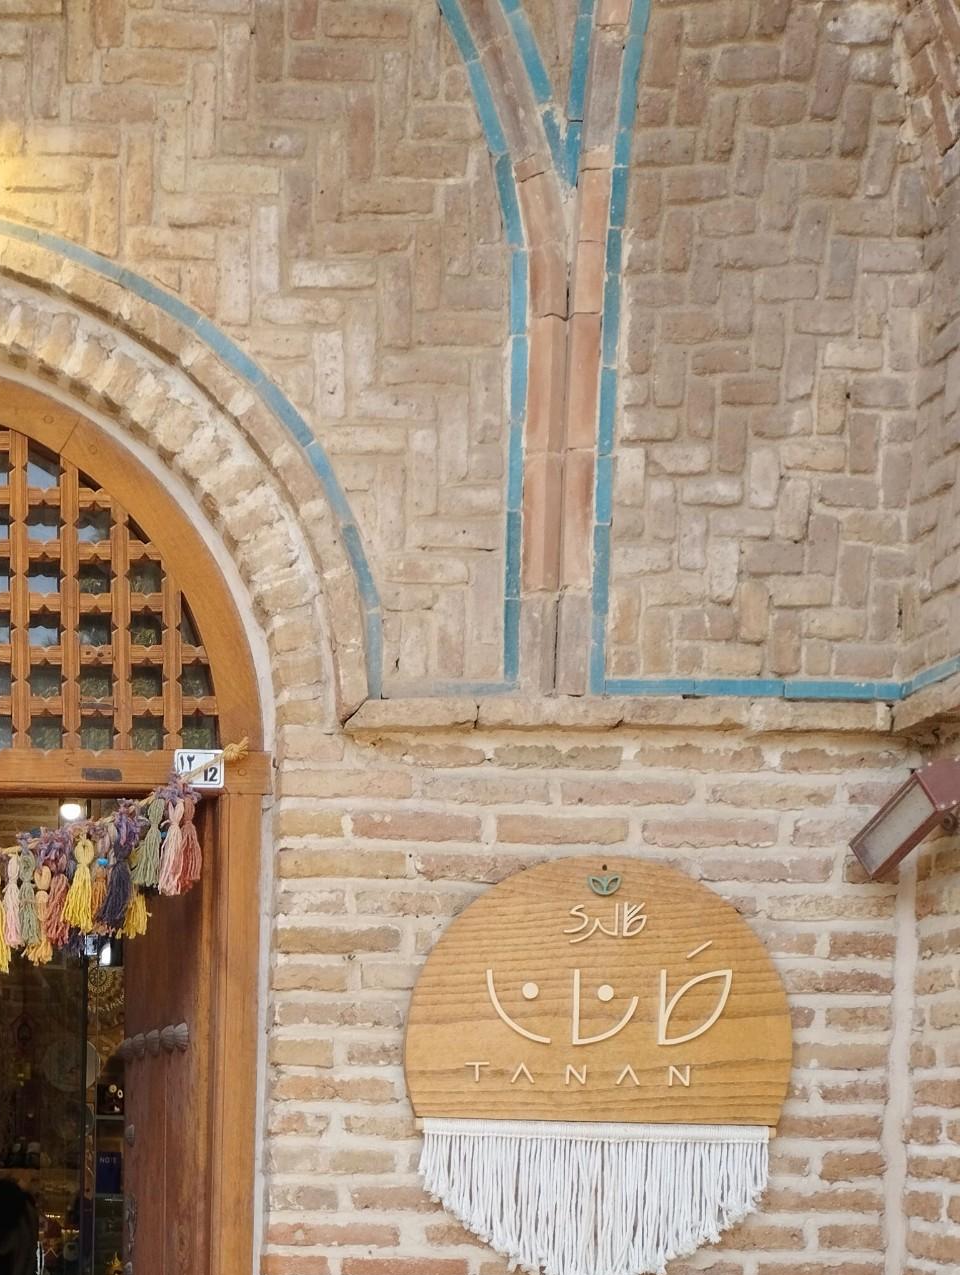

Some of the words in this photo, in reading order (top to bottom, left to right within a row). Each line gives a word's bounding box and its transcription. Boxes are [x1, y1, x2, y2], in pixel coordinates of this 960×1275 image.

[204, 767, 217, 781] 12
[563, 902, 647, 943] گالری
[465, 1062, 690, 1086] TANAN
